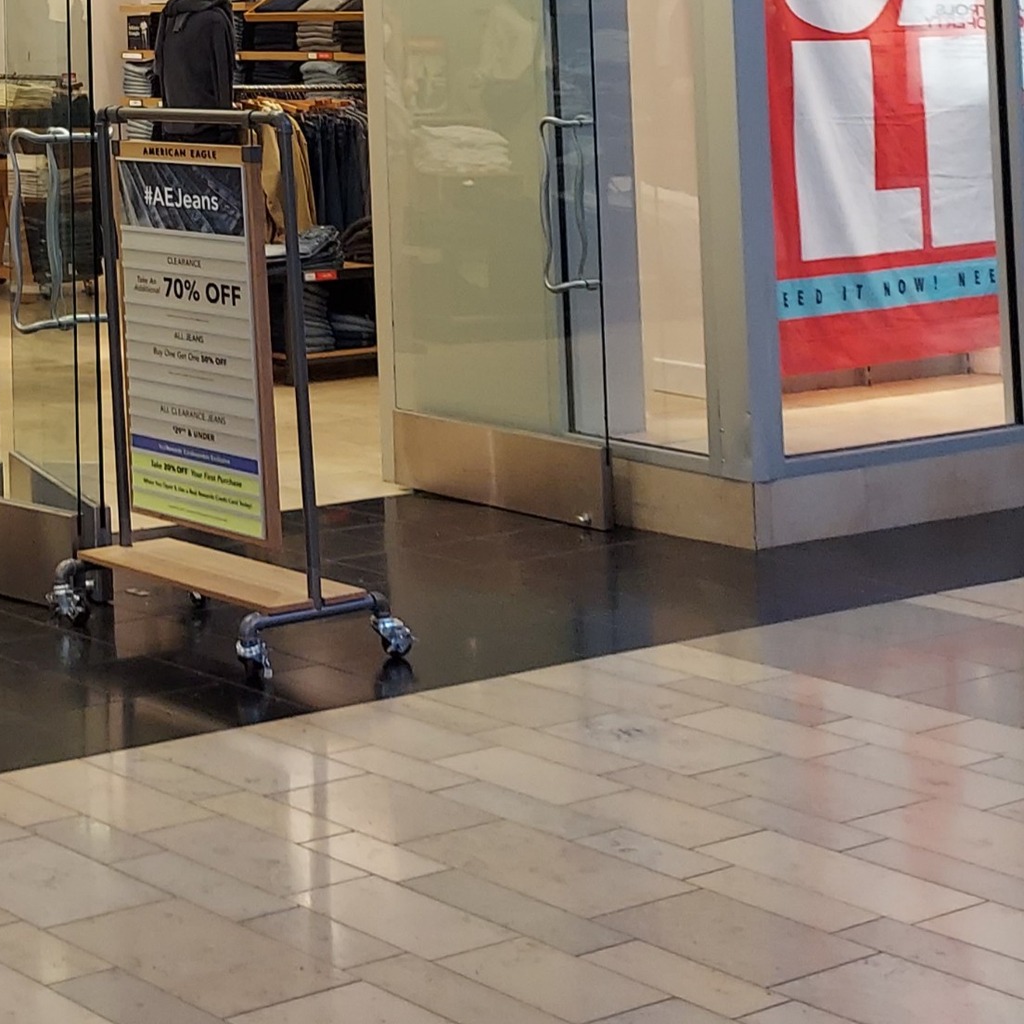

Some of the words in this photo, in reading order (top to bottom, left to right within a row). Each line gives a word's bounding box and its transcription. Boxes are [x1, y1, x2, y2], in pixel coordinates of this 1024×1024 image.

[142, 146, 186, 158] AMERICAN
[190, 149, 217, 160] EAGLE
[144, 185, 219, 212] #AEJeans
[167, 256, 202, 269] CLEARANCE
[163, 277, 200, 302] 70%
[205, 282, 241, 307] OFF
[842, 284, 864, 302] IT
[883, 275, 938, 297] NOW!
[185, 333, 205, 344] JEANS
[171, 407, 205, 422] CLEARANCE
[207, 414, 226, 426] JEANS
[194, 431, 215, 442] UNDER
